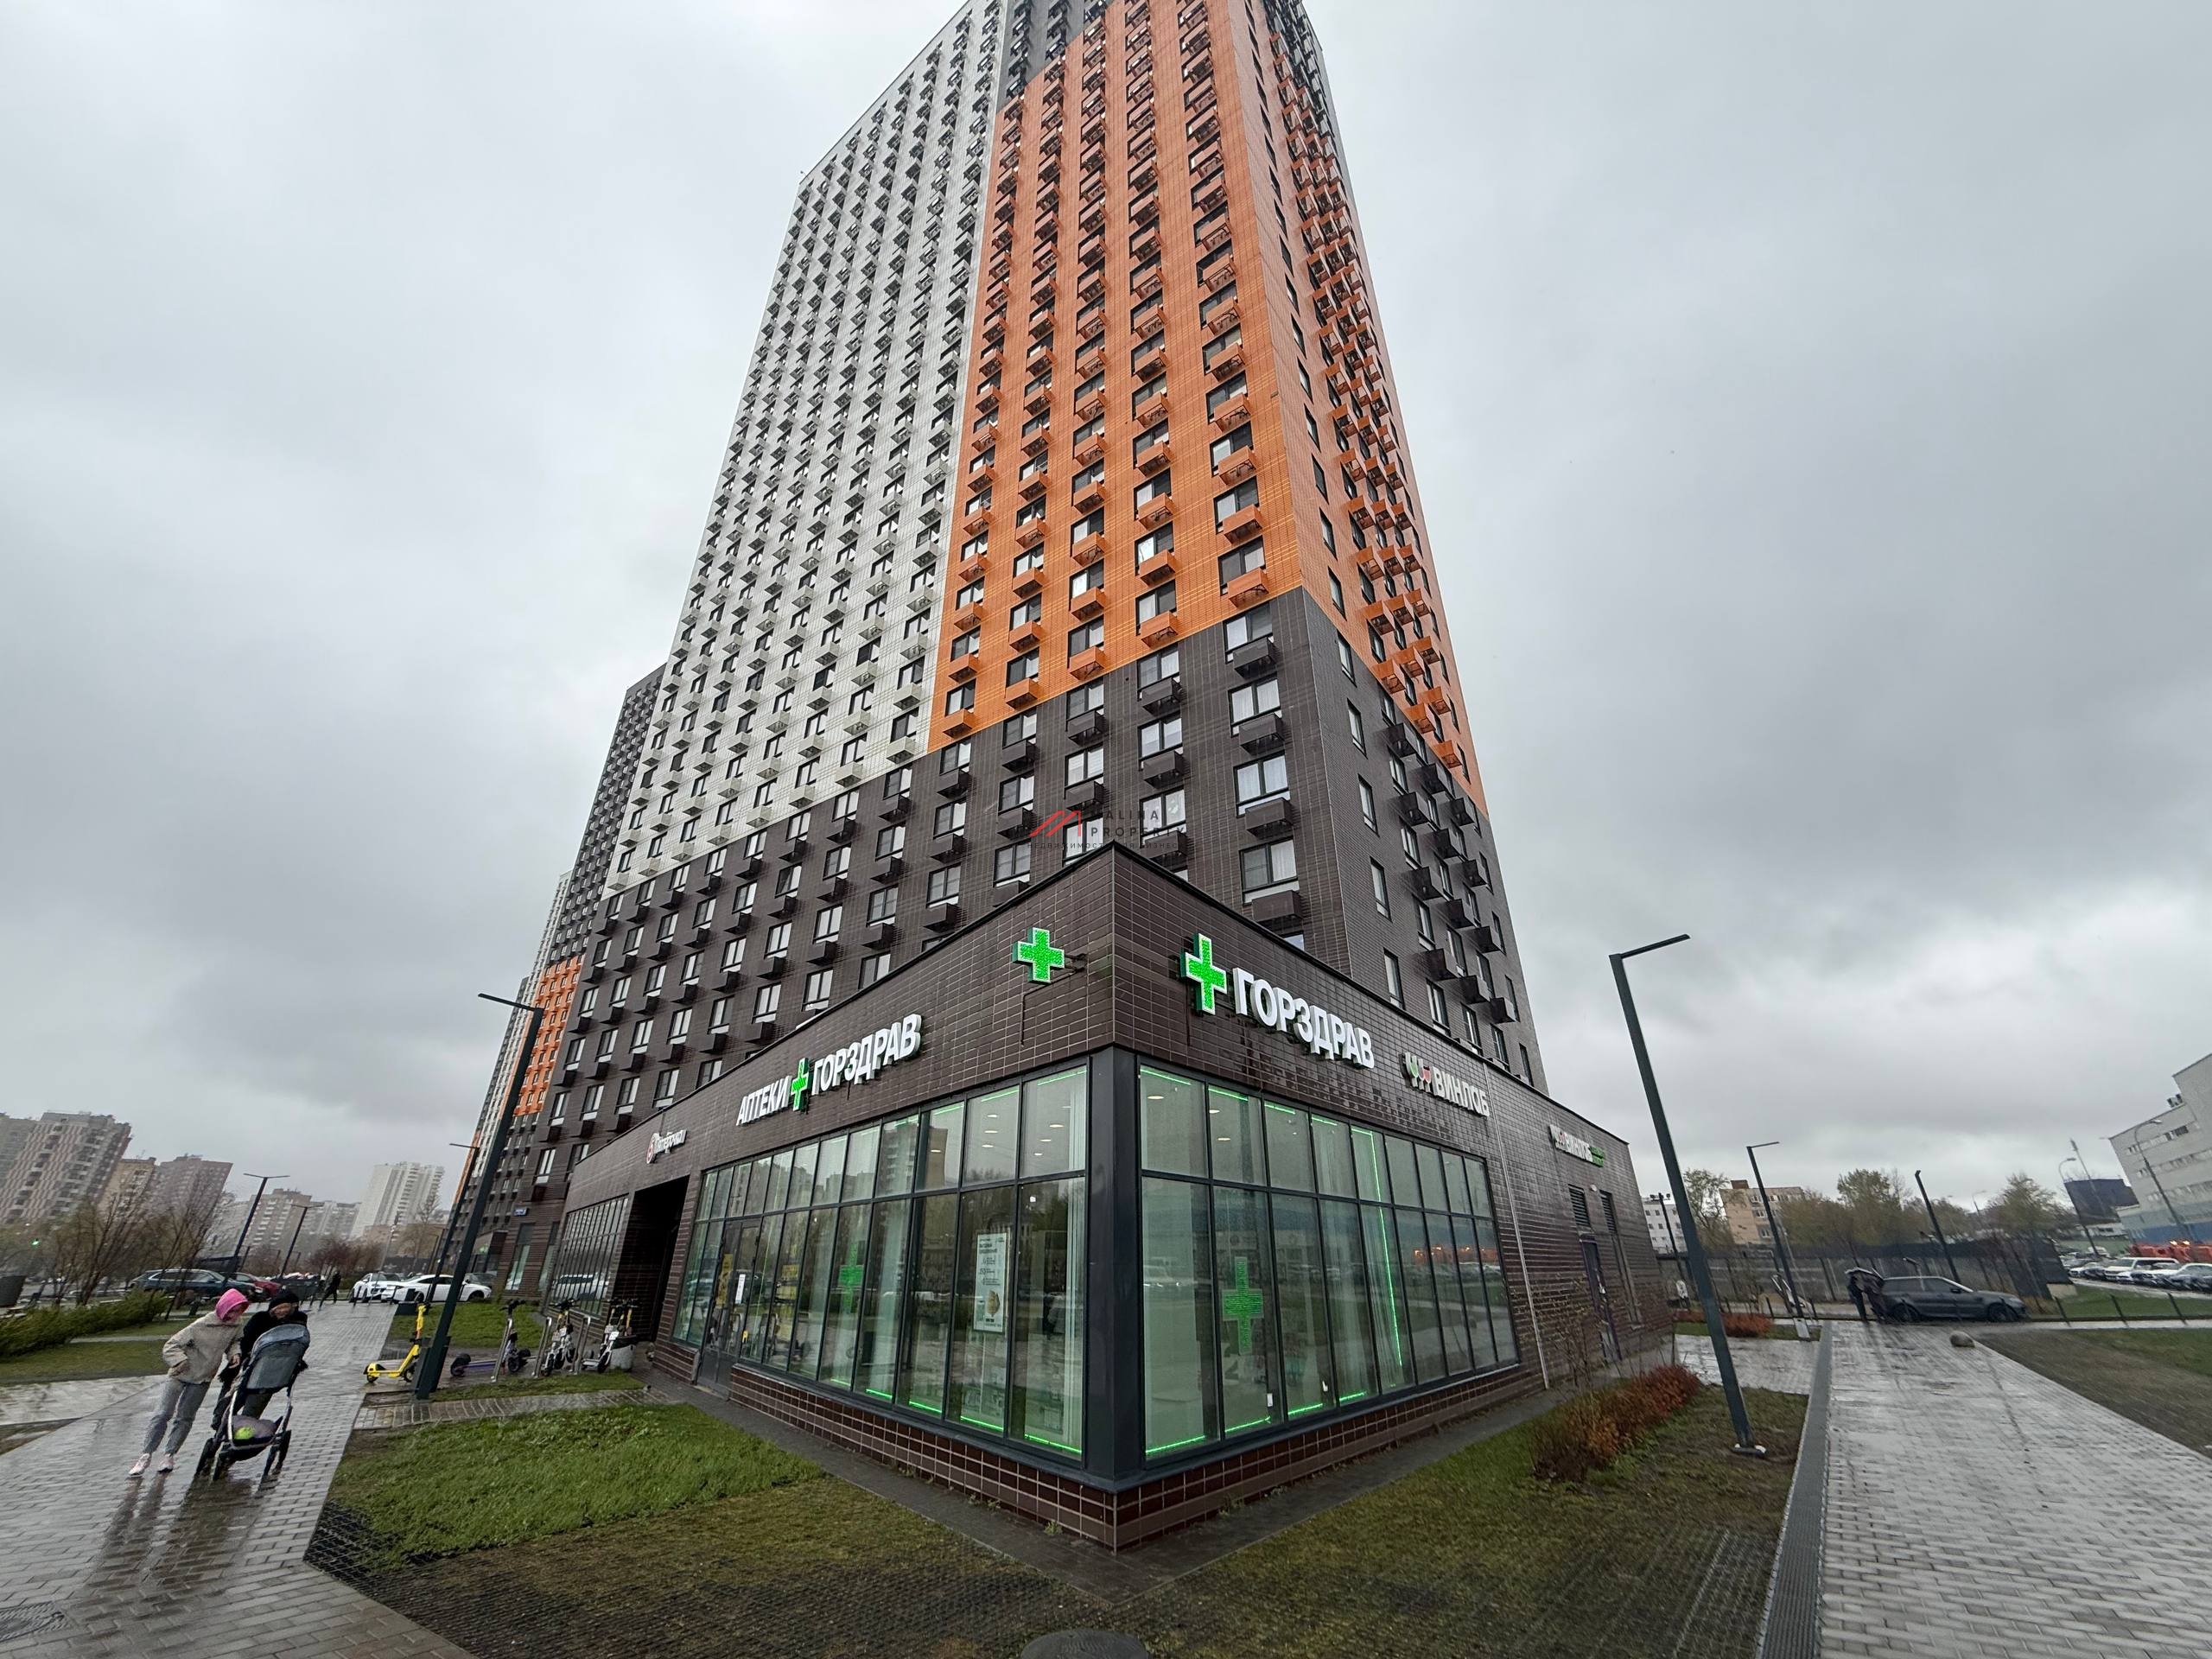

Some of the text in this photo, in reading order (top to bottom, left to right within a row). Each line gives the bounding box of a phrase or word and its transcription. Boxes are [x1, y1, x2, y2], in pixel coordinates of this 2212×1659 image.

[736, 1014, 922, 1127] АПТЕКИ ГОРЗДРАВ
[1233, 967, 1375, 1069] ГОРЗДРАВ
